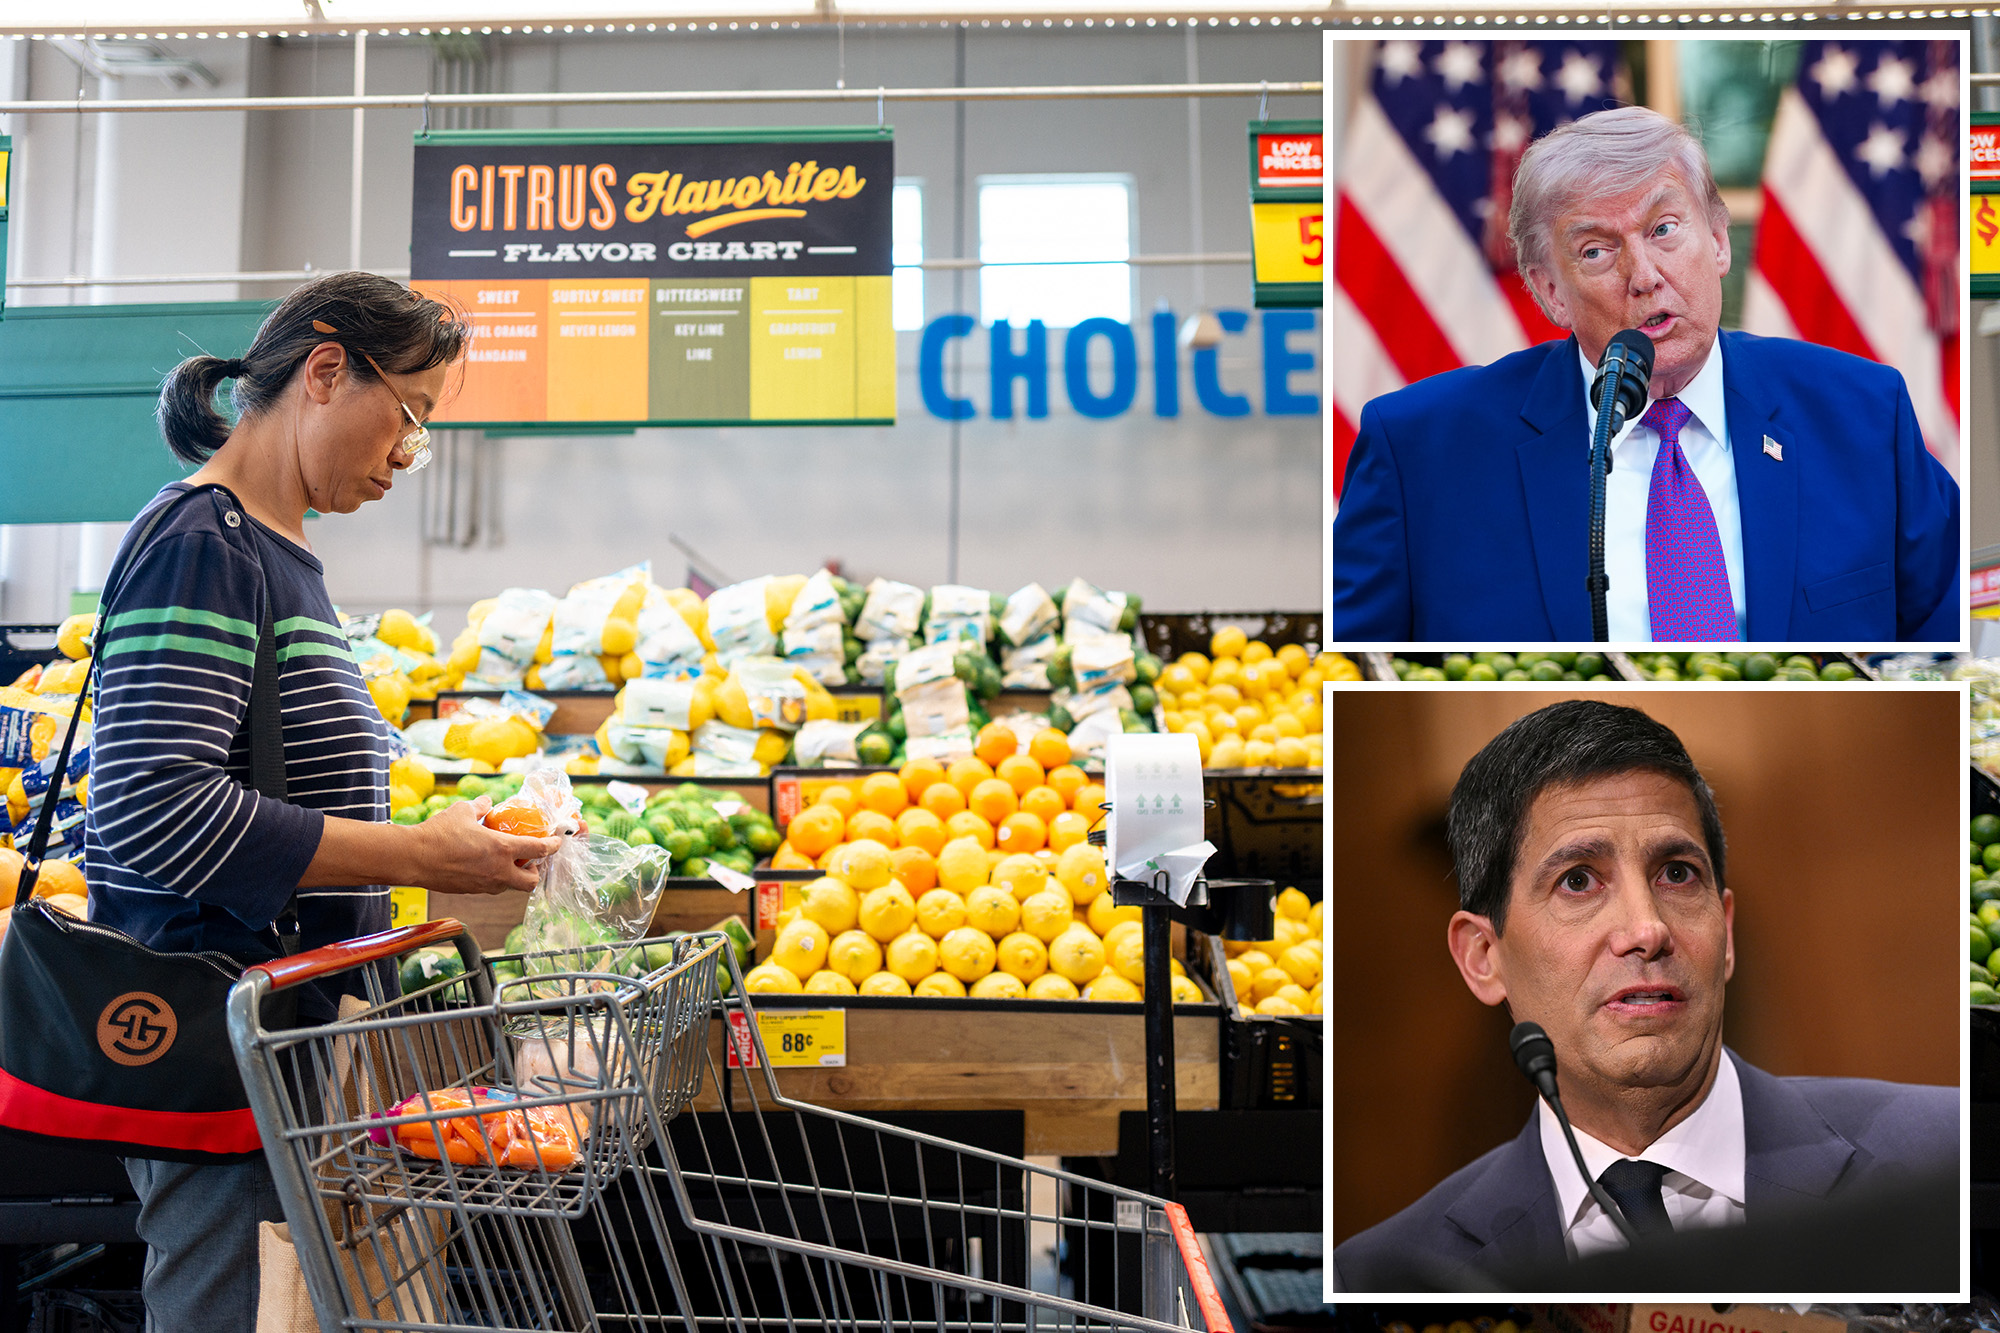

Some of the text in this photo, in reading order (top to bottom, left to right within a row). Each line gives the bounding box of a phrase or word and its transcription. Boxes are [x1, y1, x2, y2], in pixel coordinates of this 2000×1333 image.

[1270, 141, 1313, 156] LOW
[1262, 155, 1323, 170] PRICES
[450, 160, 867, 232] CITRUS Flavorites
[503, 240, 804, 262] FLAVOR CHART
[477, 290, 520, 304] SWEET
[552, 289, 645, 304] SUBTLY SWEET
[656, 288, 744, 303] BITTERSWEET
[786, 288, 820, 301] TART
[494, 325, 538, 338] ORANGE
[560, 325, 636, 338] MEYER LEMON
[674, 323, 725, 337] KEY LIME
[468, 349, 527, 363] MANDARIN
[686, 348, 713, 361] LIME
[784, 347, 822, 360] LEMON
[919, 311, 1320, 421] CHOICE
